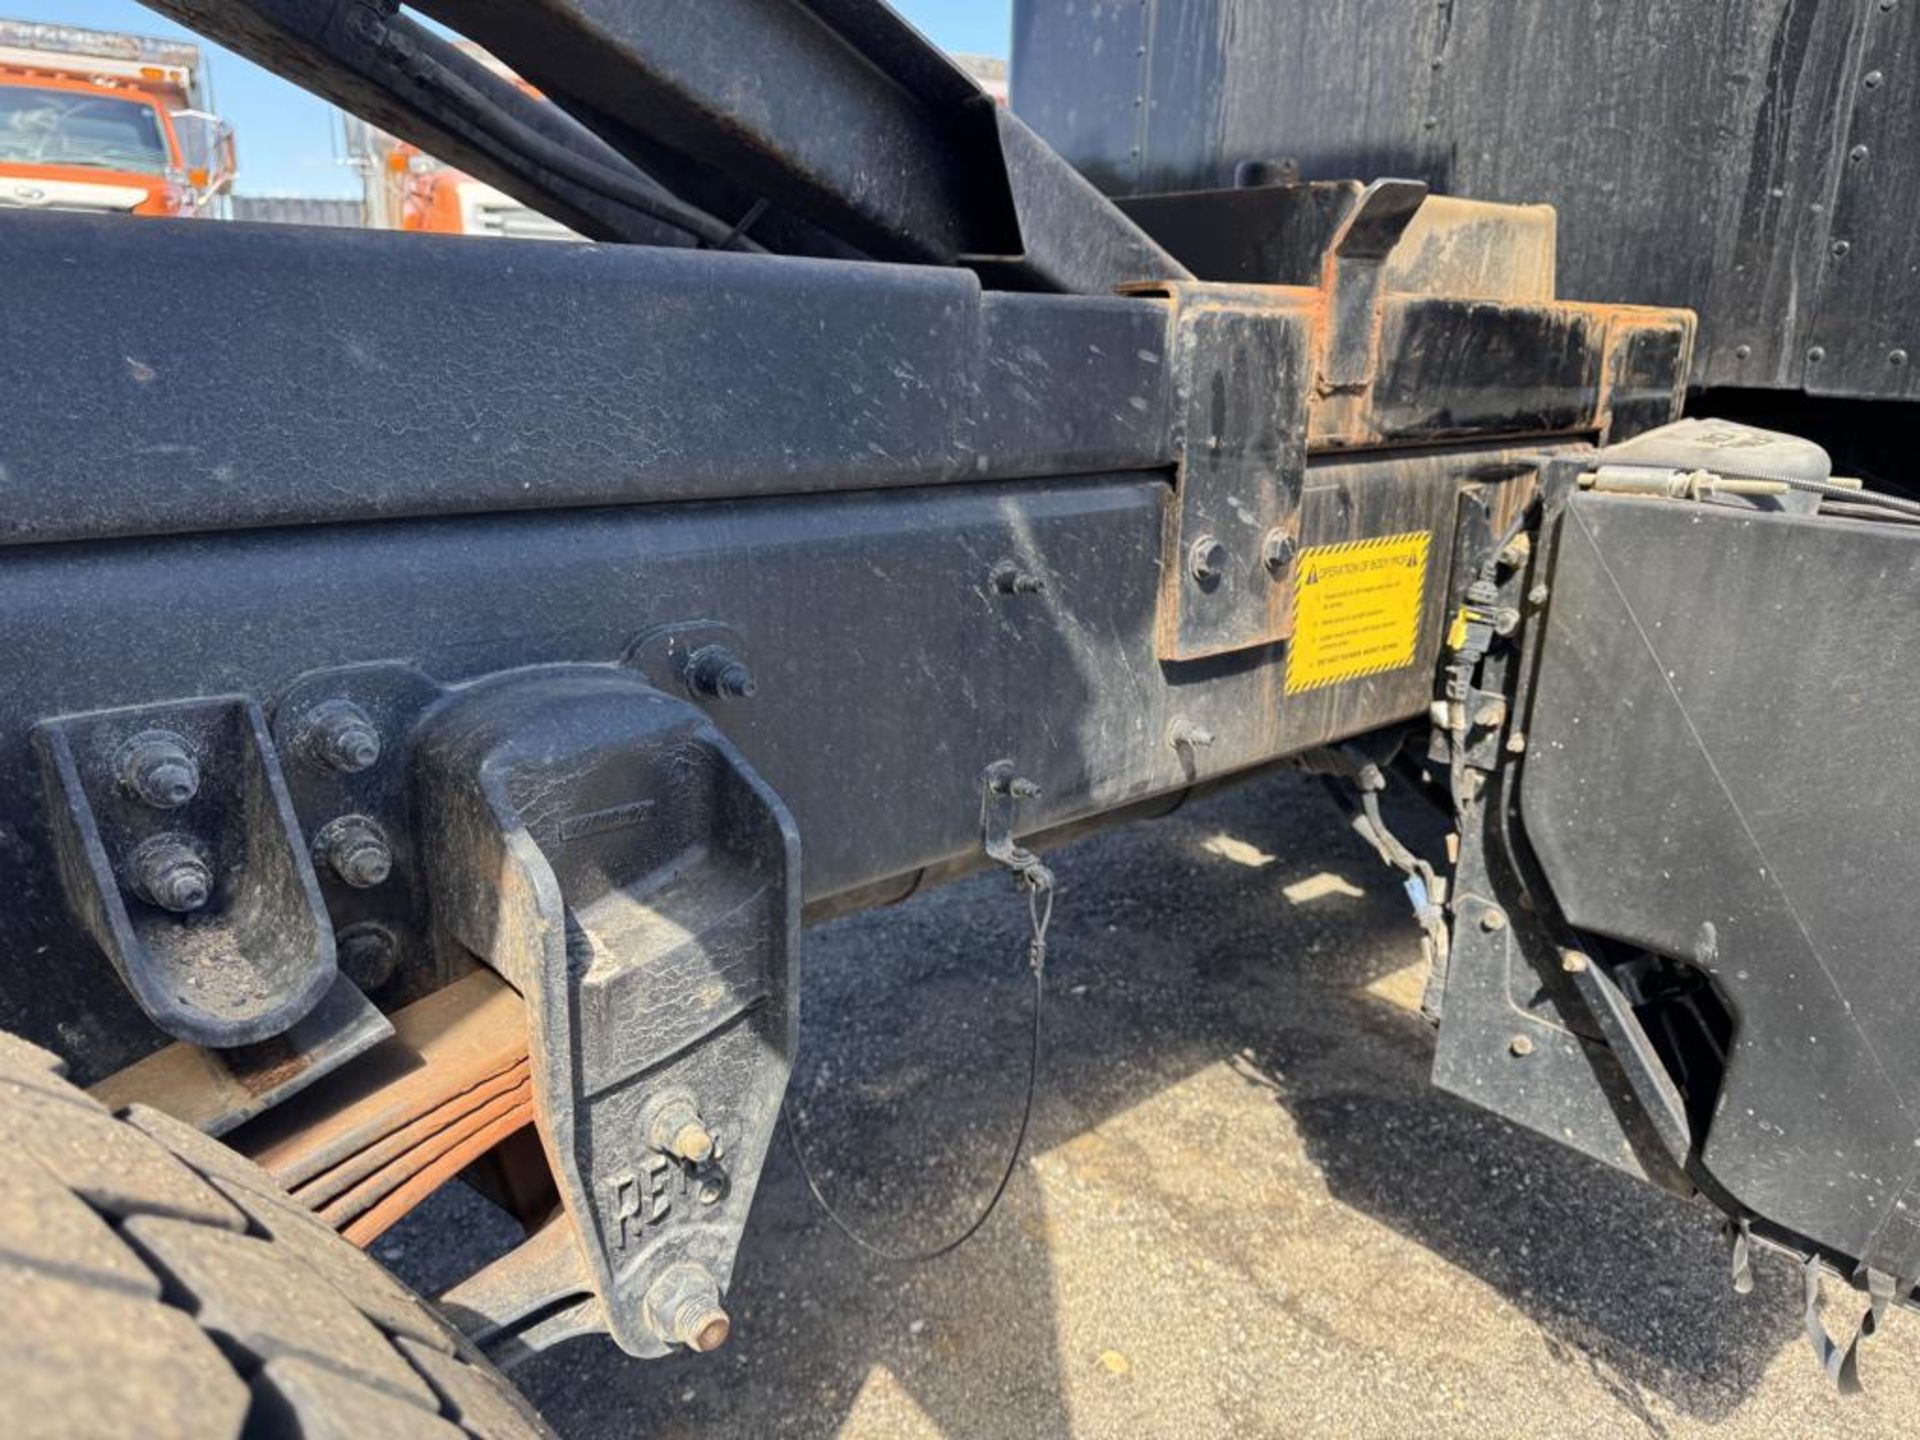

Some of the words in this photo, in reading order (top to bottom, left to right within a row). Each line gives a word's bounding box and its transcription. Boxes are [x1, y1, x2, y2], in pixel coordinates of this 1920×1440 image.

[1319, 561, 1358, 578] OPERATION
[1360, 560, 1369, 572] OF
[1370, 557, 1389, 570] BODY
